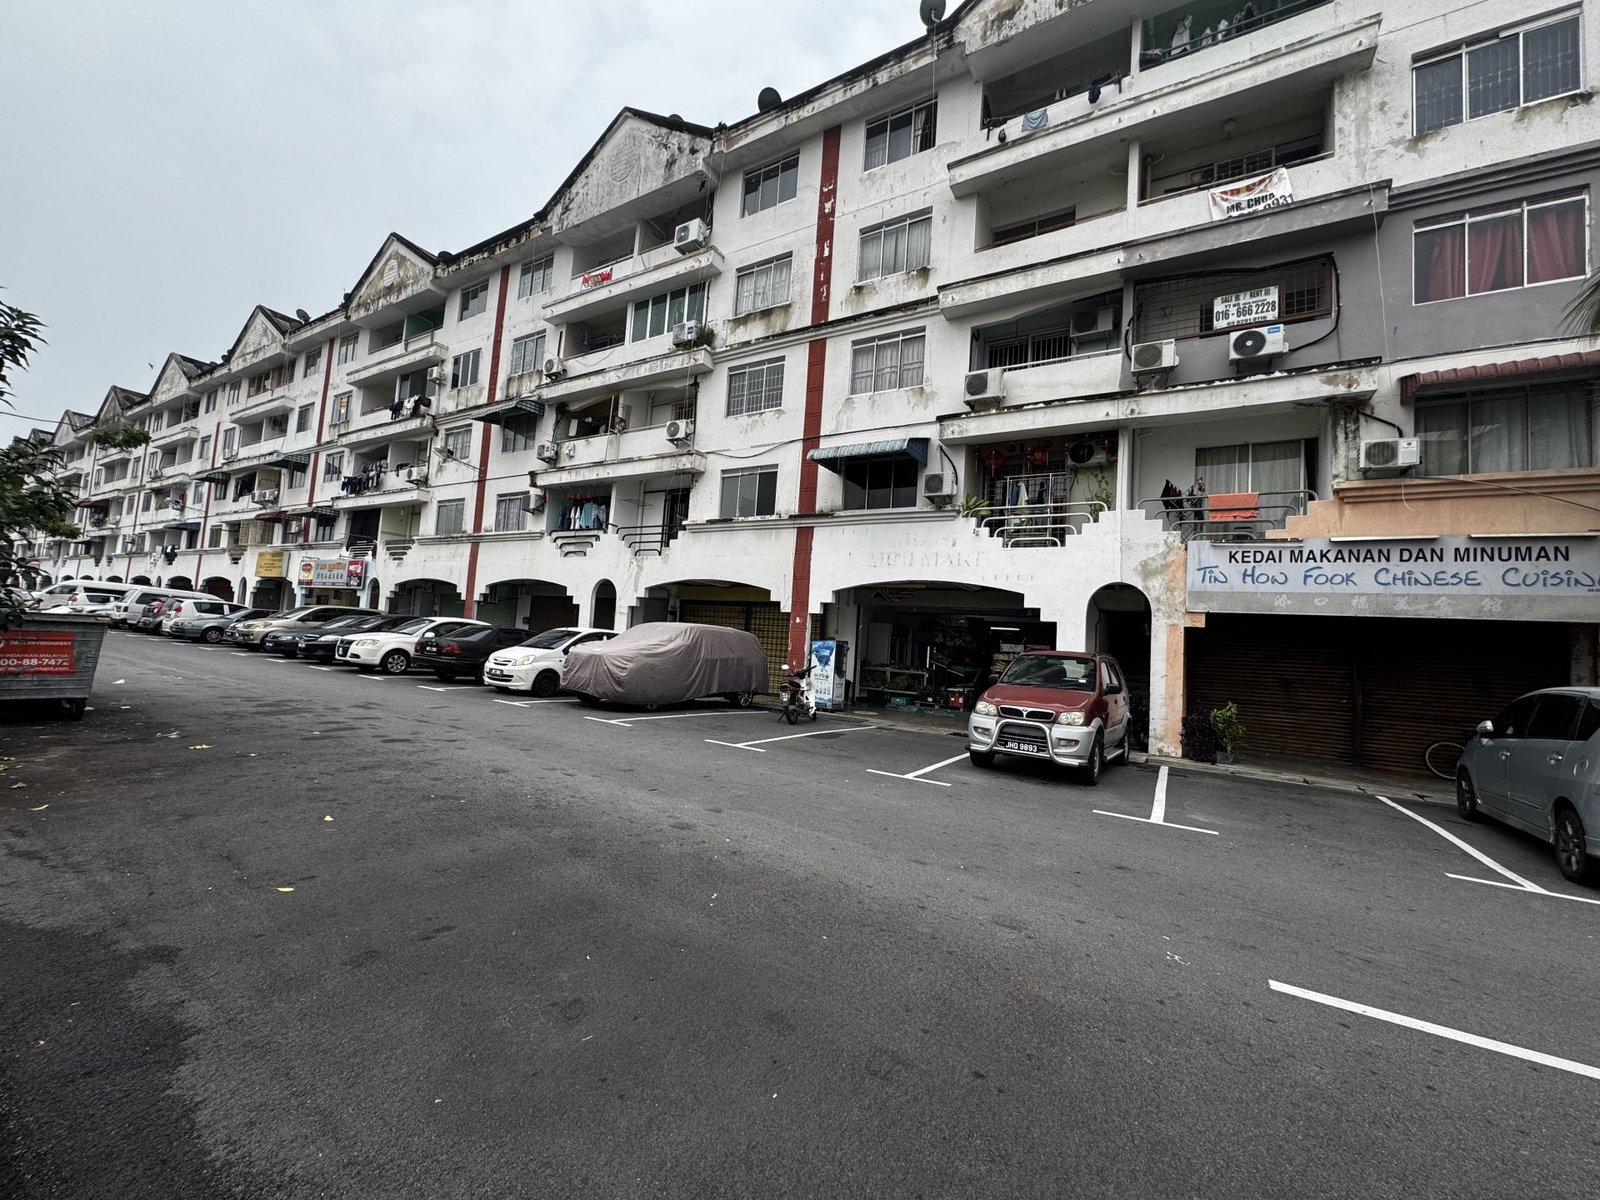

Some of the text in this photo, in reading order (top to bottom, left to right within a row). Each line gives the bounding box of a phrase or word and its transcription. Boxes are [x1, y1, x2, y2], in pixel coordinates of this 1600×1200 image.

[1226, 202, 1246, 215] MR.
[1247, 192, 1276, 209] CHUA
[1215, 308, 1230, 322] 016
[1236, 304, 1254, 318] 666
[1254, 300, 1277, 315] 2228
[1228, 545, 1570, 564] KEDAI MAKANAN DAN MINUMAN
